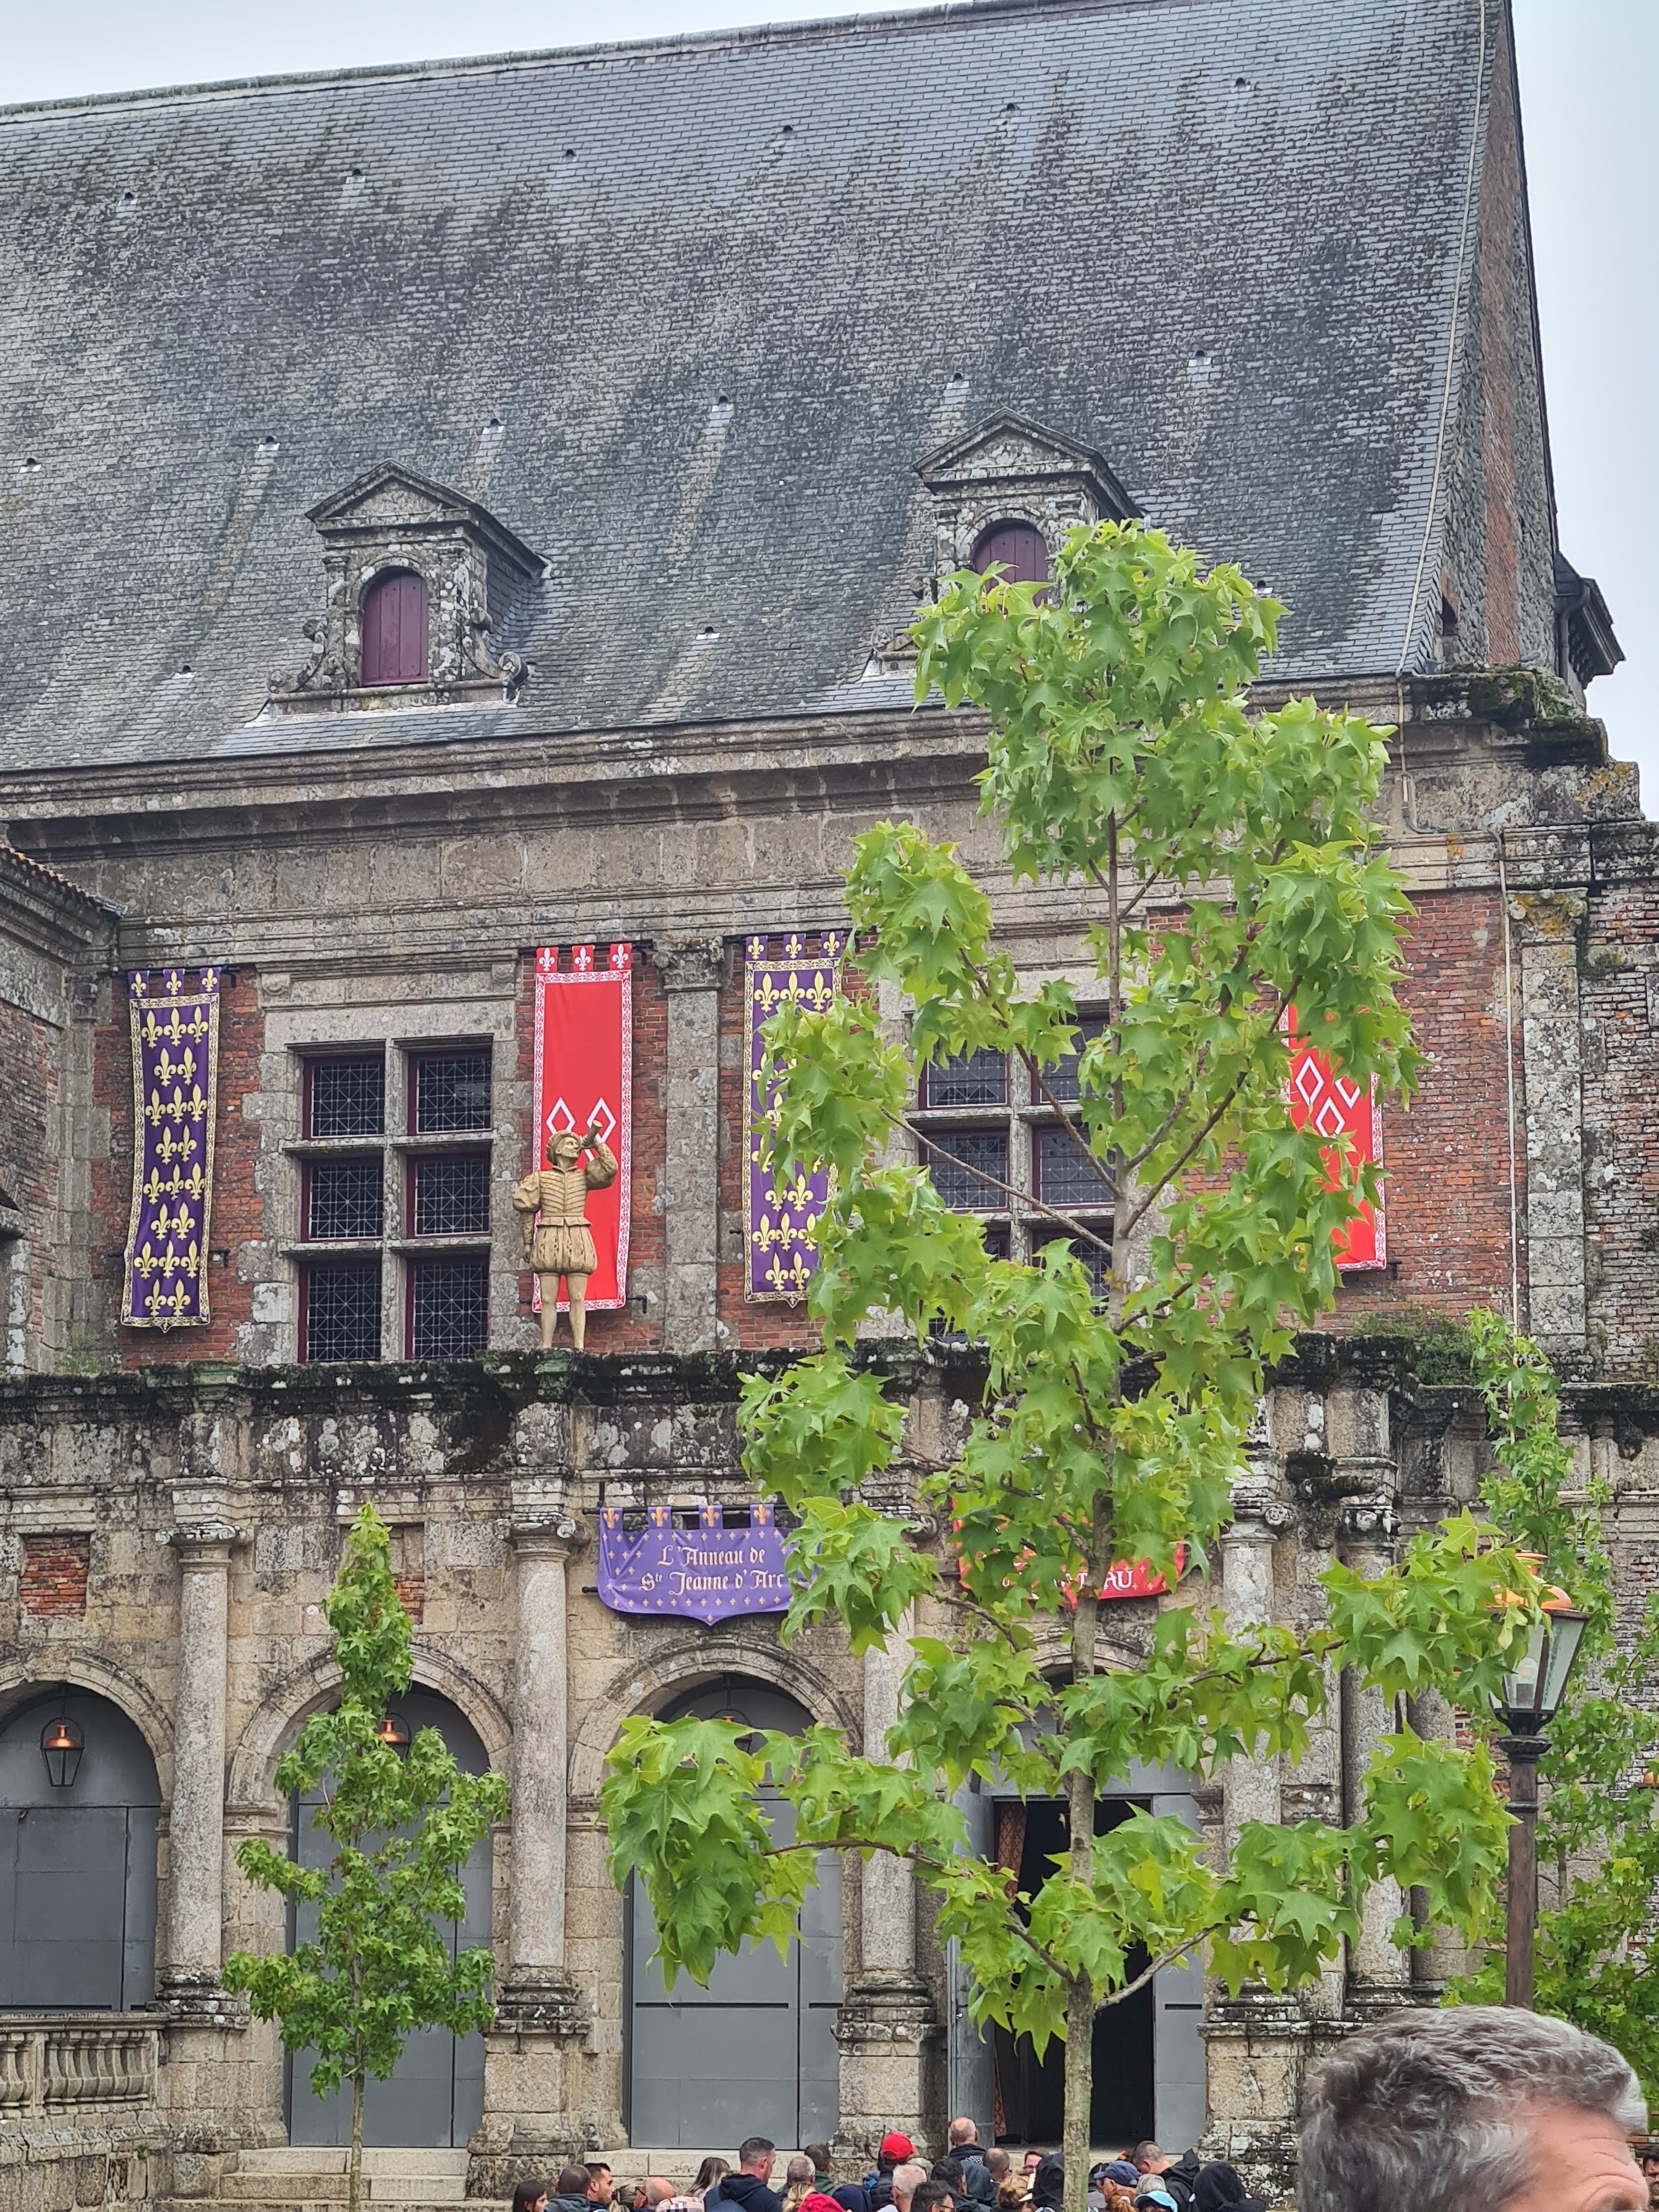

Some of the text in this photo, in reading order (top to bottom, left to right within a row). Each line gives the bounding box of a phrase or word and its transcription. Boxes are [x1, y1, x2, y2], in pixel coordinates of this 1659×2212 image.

[657, 1544, 765, 1566] L'Anneau de
[639, 1568, 784, 1596] Ste Jeanne d'Arc
